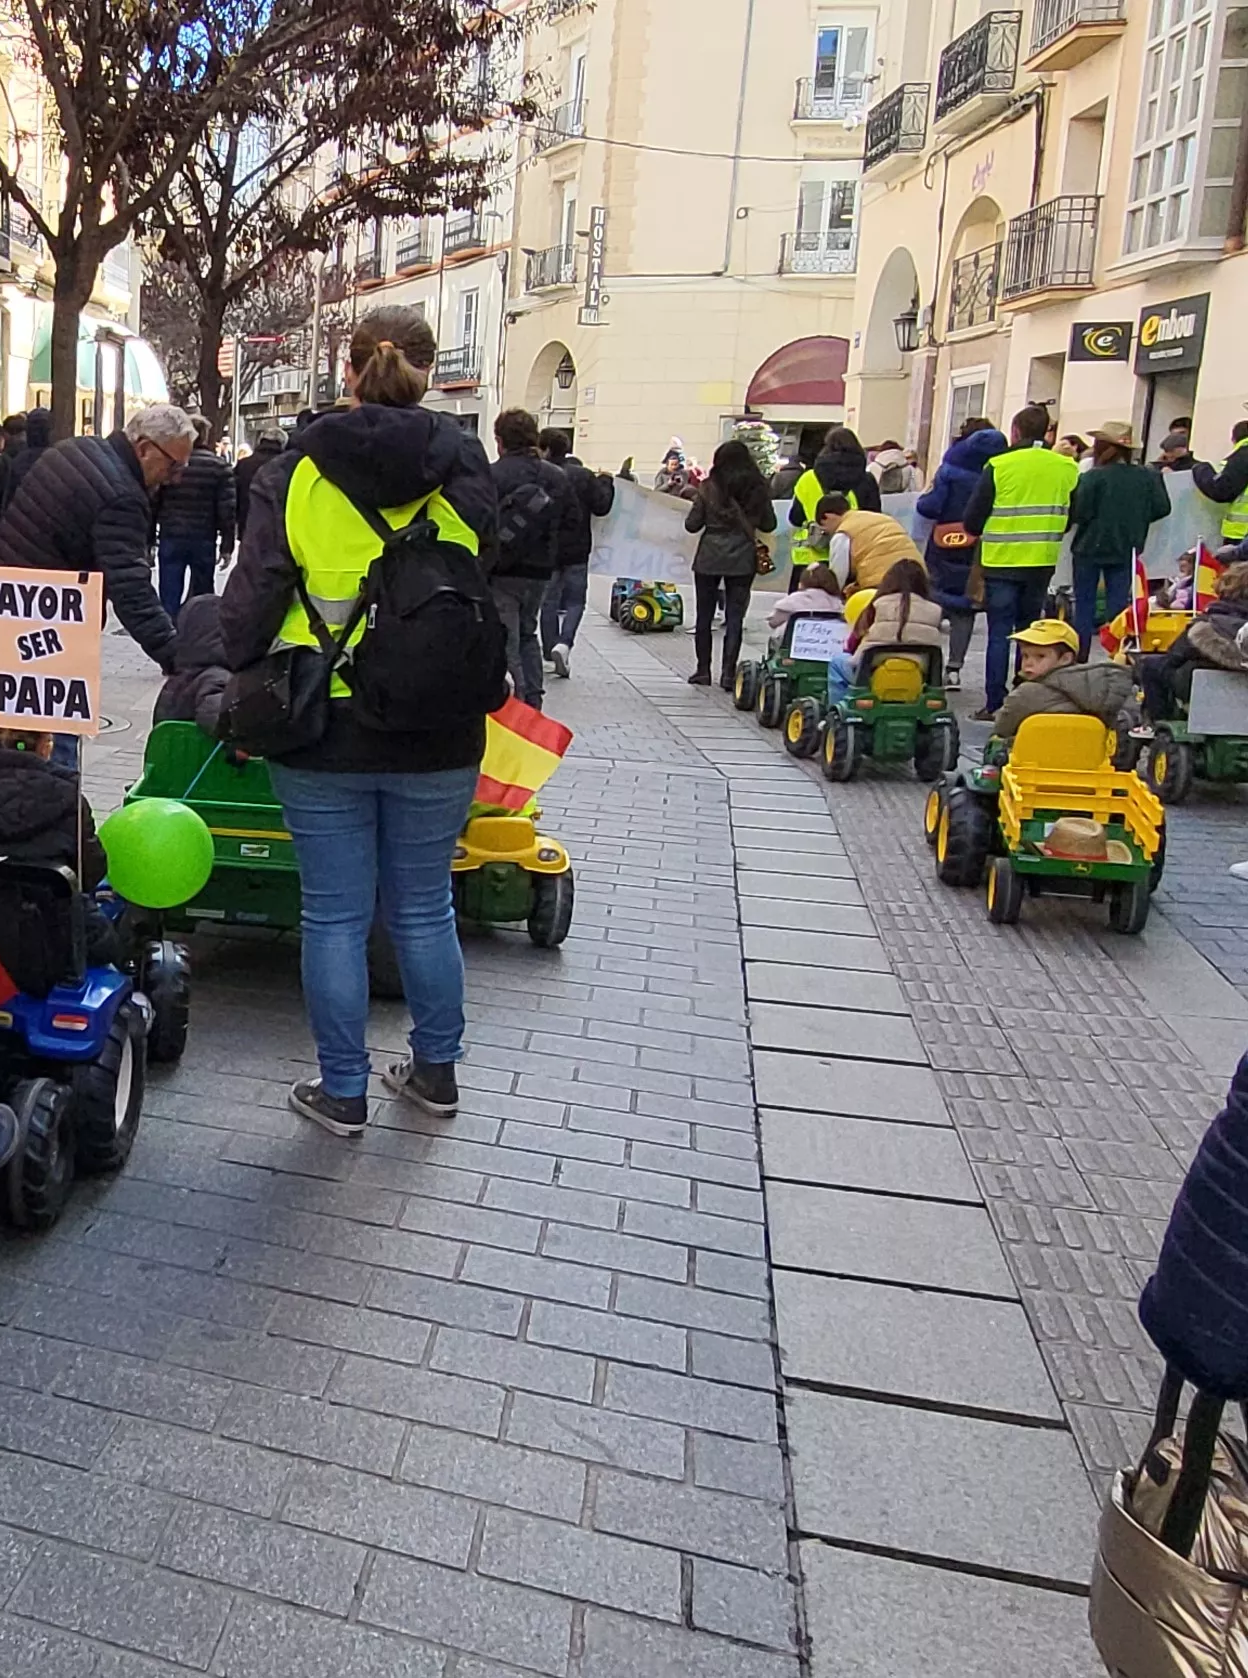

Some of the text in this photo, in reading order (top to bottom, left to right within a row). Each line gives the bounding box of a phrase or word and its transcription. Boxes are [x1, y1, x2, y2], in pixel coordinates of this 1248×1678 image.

[590, 208, 605, 306] HOSTAL
[1140, 308, 1196, 346] embou
[17, 628, 64, 661] SER
